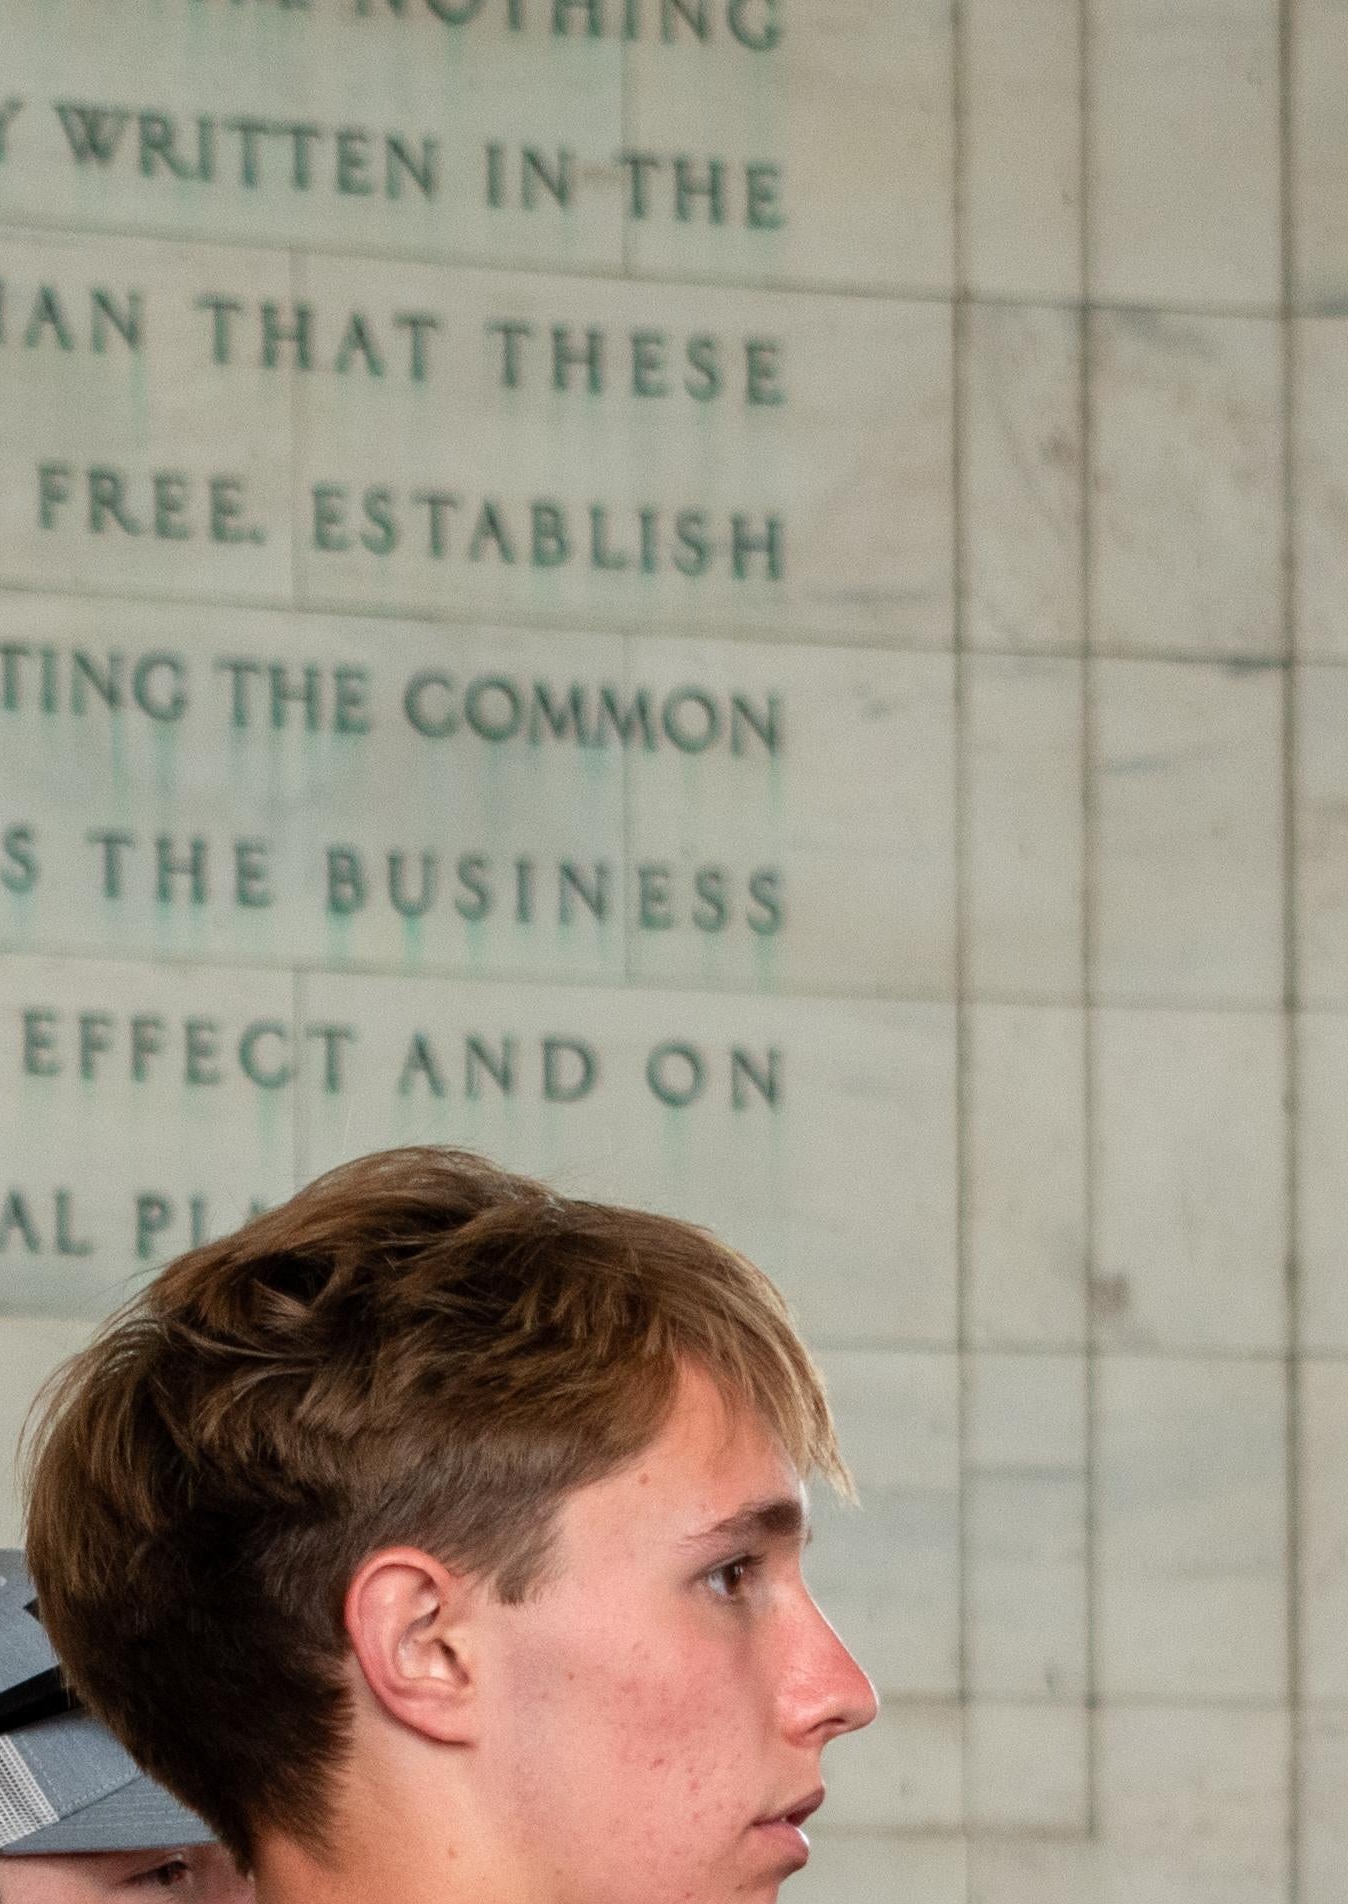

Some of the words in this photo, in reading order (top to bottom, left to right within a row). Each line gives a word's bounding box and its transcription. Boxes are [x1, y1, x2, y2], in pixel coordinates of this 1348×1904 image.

[56, 102, 439, 200] WRITTEN
[484, 141, 574, 212] IN
[614, 151, 787, 231] THE
[195, 292, 441, 383] THAT
[488, 318, 787, 406] THESE
[38, 461, 265, 545] FREE.
[313, 482, 785, 582] ESTABLISH
[216, 660, 372, 735] THE
[404, 668, 787, 756] COMMON
[89, 829, 275, 909] THE
[326, 843, 787, 935] BUSINESS
[22, 1008, 356, 1094] EFFECT
[399, 1032, 599, 1104] AND
[646, 1040, 785, 1110] ON
